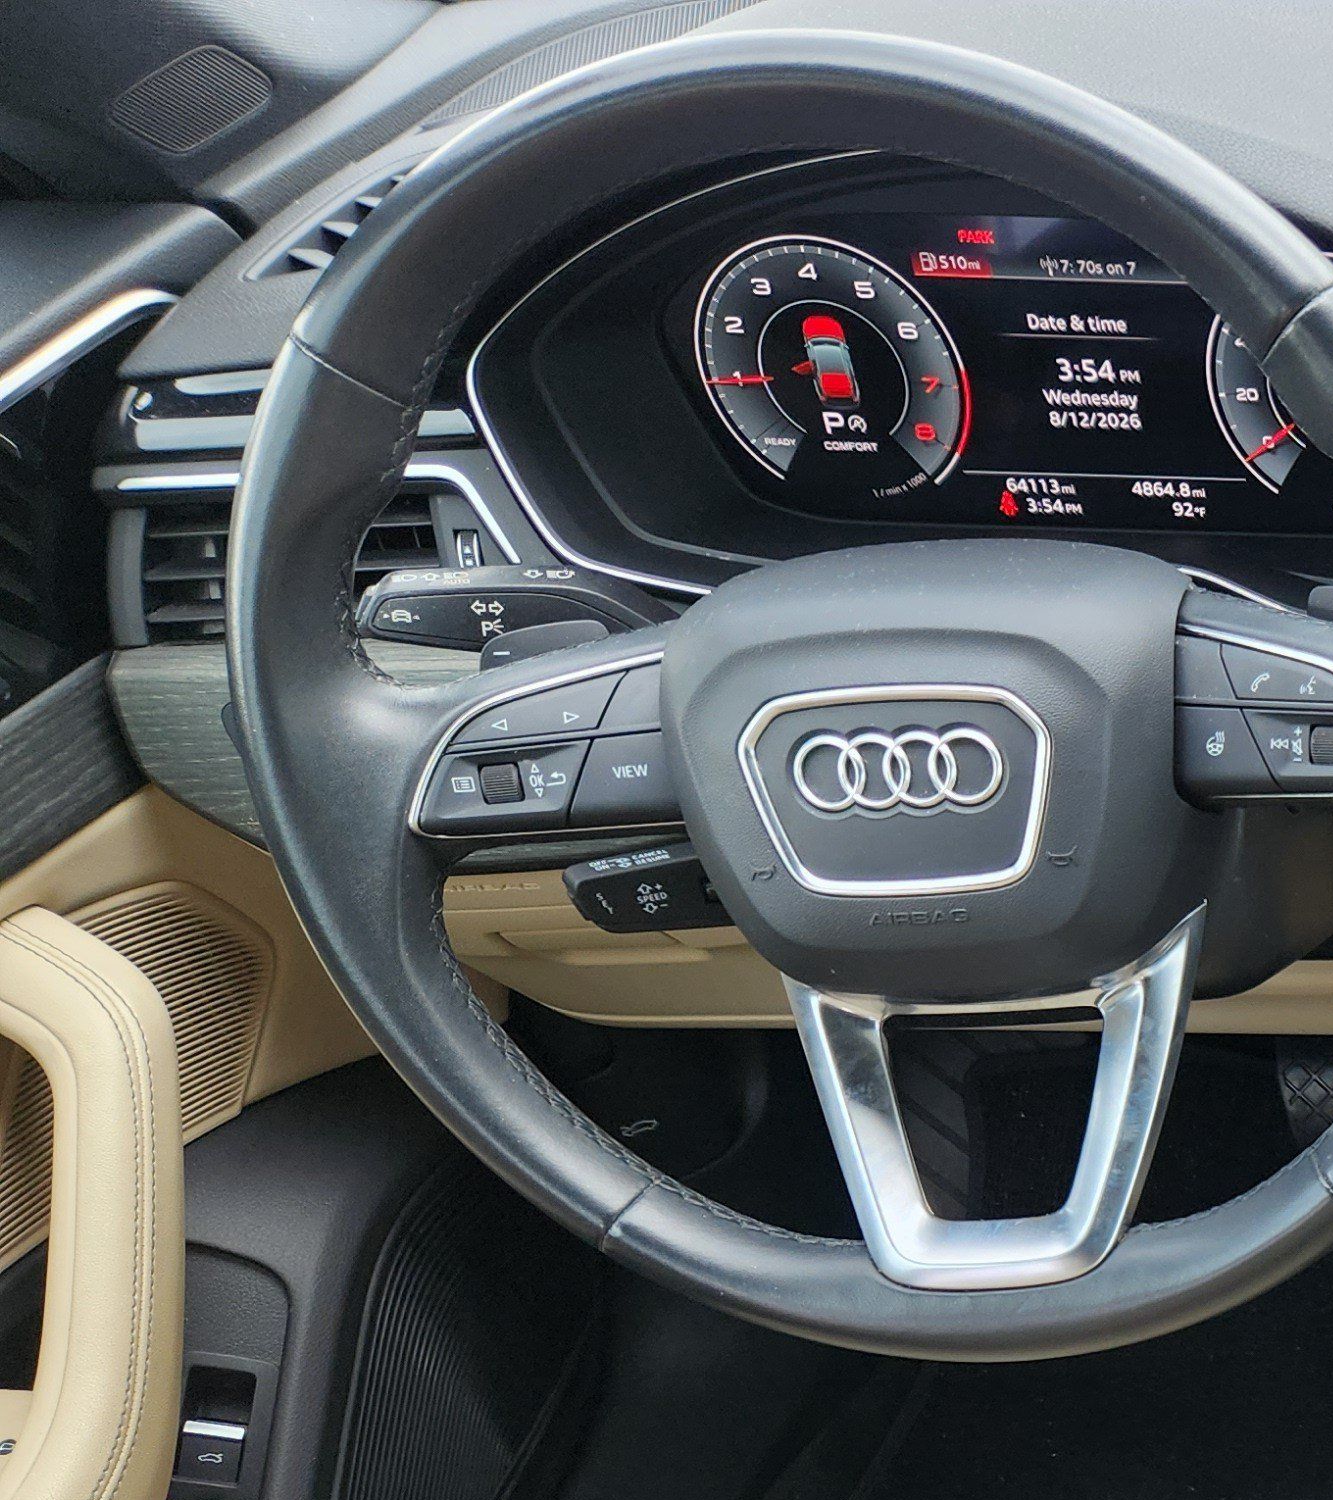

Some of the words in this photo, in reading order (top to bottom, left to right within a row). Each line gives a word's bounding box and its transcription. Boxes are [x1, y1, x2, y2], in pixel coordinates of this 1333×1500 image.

[957, 229, 995, 244] PARK
[798, 263, 818, 281] 4
[1076, 259, 1103, 275] 70s
[1107, 263, 1123, 275] on
[1126, 261, 1137, 276] 7
[750, 278, 772, 295] 3
[853, 281, 876, 299] 5
[724, 316, 745, 334] 2
[897, 322, 919, 340] 6
[1026, 313, 1067, 333] Date
[1070, 314, 1085, 333] &
[1087, 314, 1127, 334] time
[1055, 357, 1116, 384] 3:54
[1119, 369, 1142, 384] PM
[921, 375, 940, 394] 7
[1042, 389, 1138, 411] Wednesday
[1235, 387, 1259, 402] 20
[822, 411, 845, 435] P
[1048, 411, 1143, 431] 8/12/2026
[914, 422, 936, 442] 8
[764, 437, 797, 446] READY
[823, 440, 878, 452] COMFORT
[906, 472, 928, 489] 1000
[612, 764, 649, 779] VIEW
[529, 774, 545, 787] OK
[631, 850, 668, 860] CANCEL
[635, 853, 671, 866] RESUME
[636, 891, 668, 904] SPEED
[869, 908, 970, 926] AIRBAG
